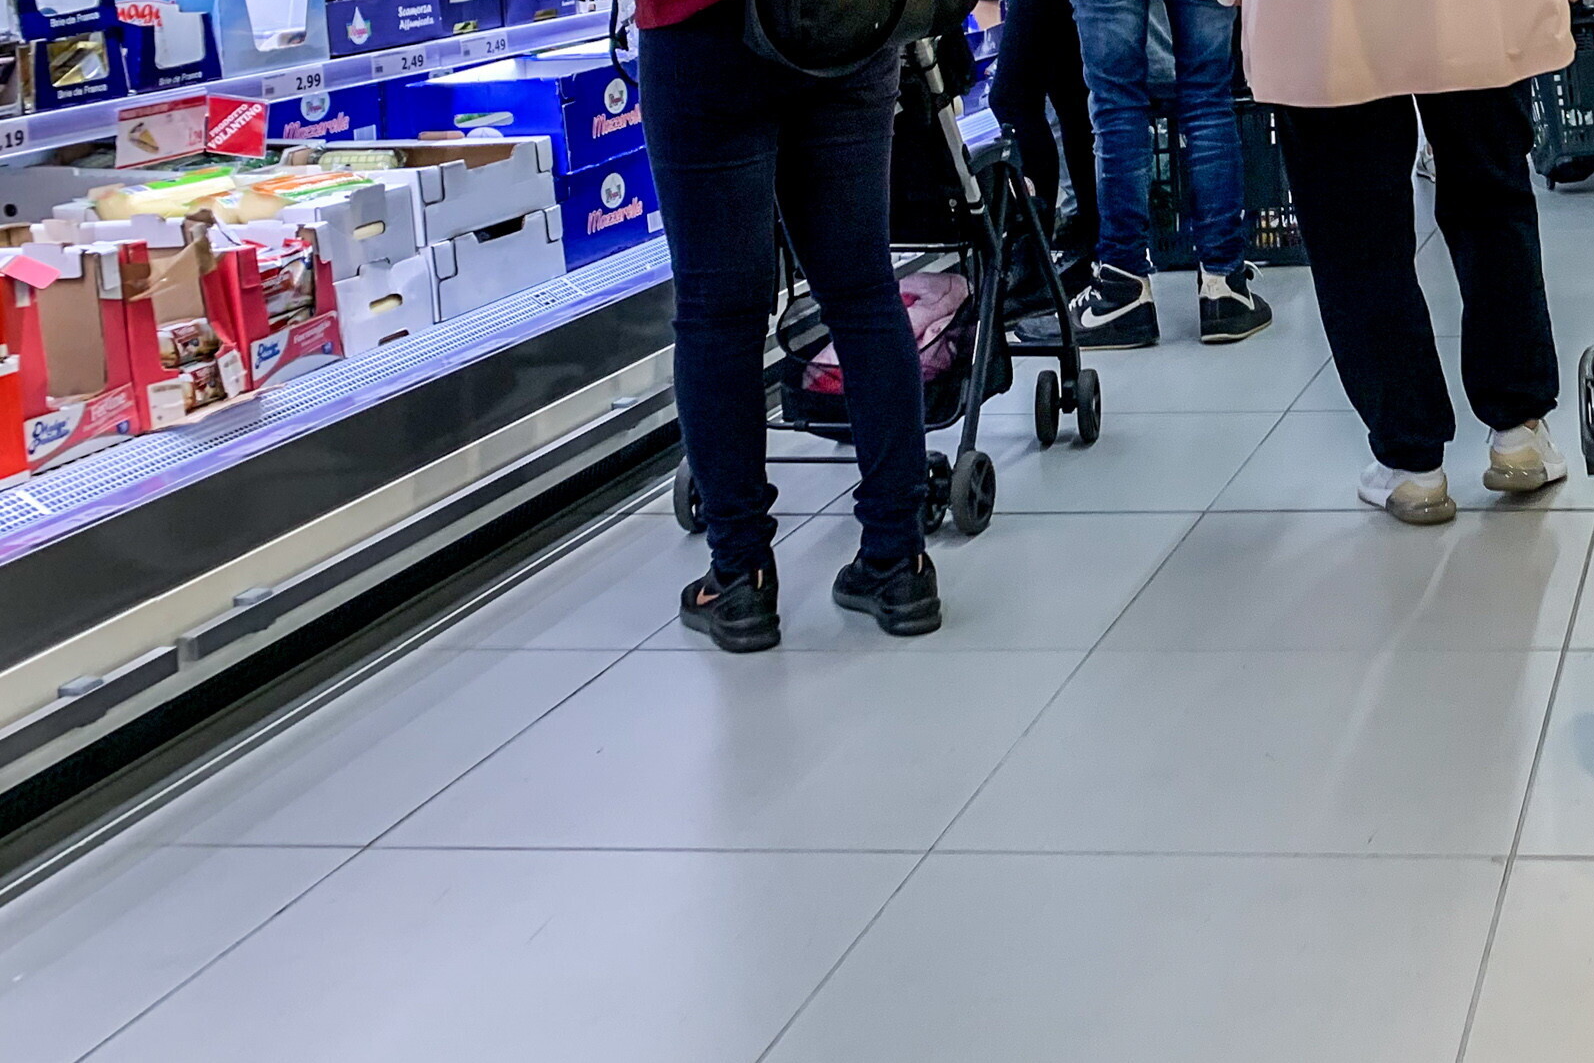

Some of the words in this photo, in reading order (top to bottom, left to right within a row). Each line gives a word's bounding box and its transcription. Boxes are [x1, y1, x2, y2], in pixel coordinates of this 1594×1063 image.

[486, 38, 506, 54] 2,49
[402, 53, 424, 71] 2,49
[296, 73, 321, 91] 2,99
[206, 103, 263, 150] VOLANTINO
[208, 103, 249, 137] PRODOTTO
